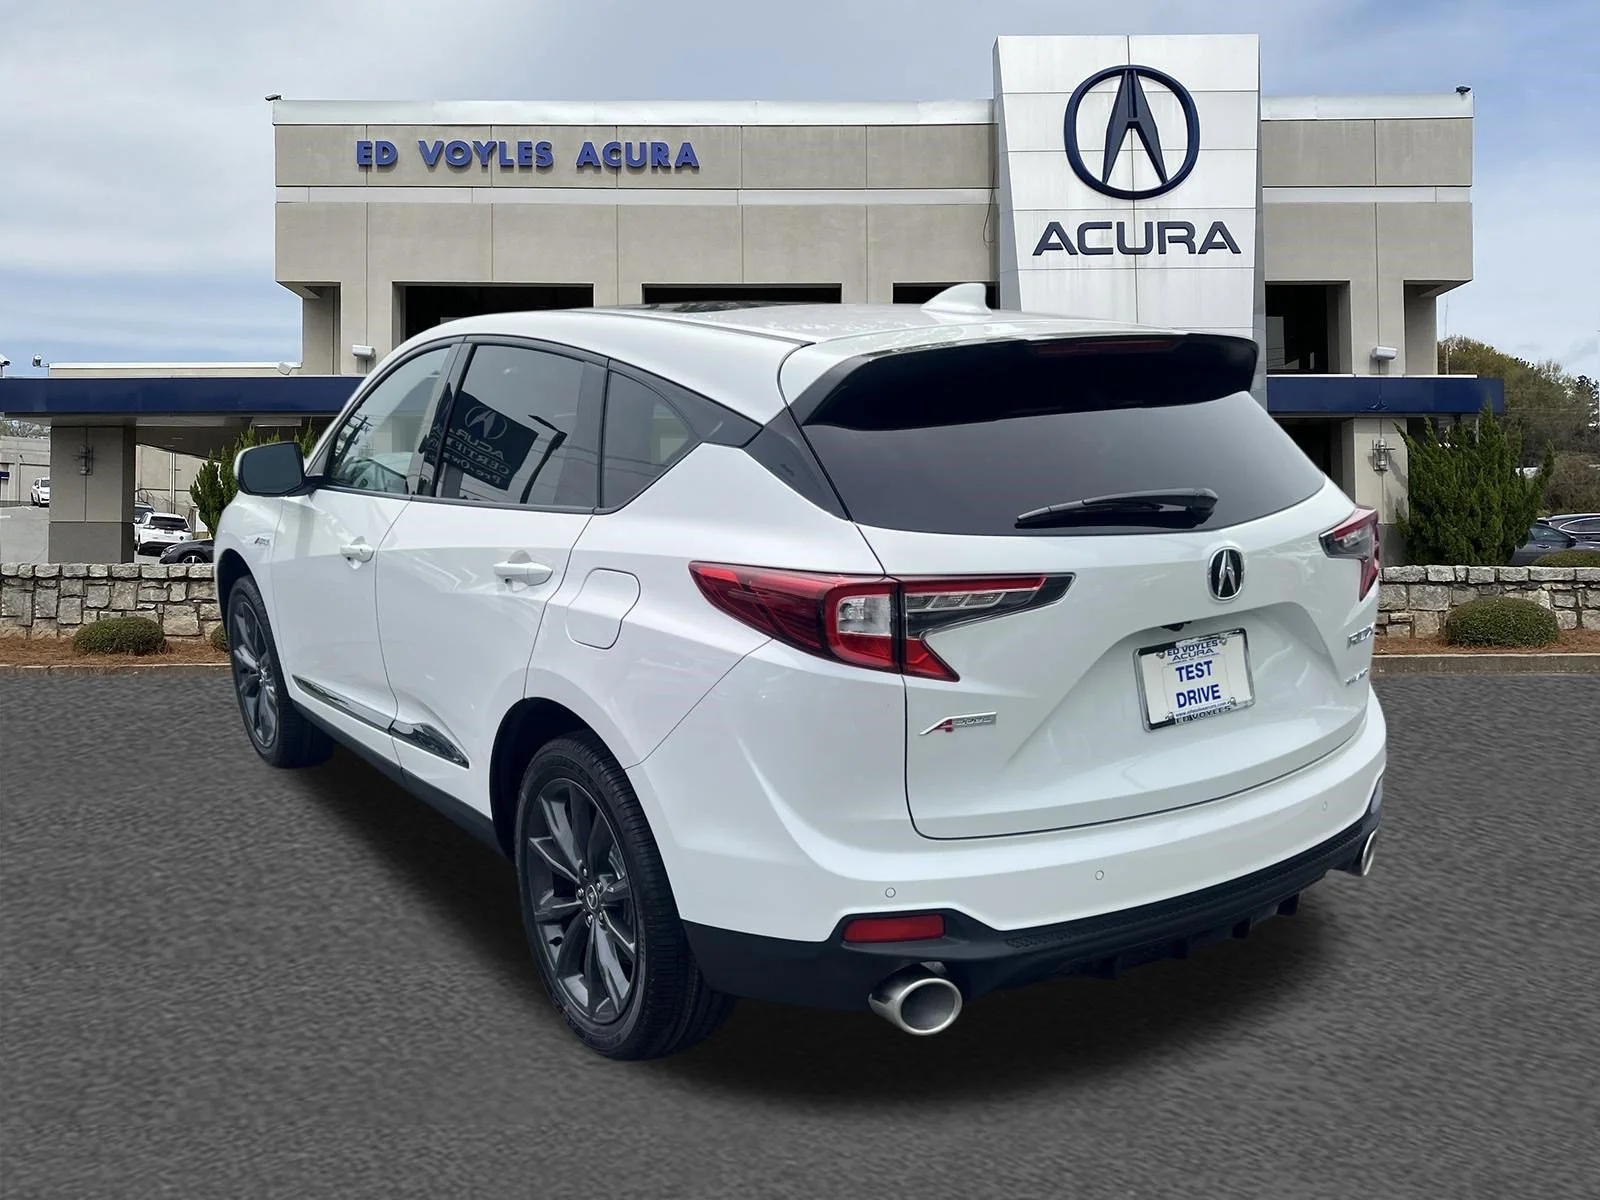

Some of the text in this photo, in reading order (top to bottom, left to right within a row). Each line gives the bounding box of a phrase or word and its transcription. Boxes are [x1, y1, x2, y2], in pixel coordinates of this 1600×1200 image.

[357, 140, 700, 168] ED VOYLES ACURA
[1032, 220, 1242, 256] ACURA
[1167, 639, 1218, 657] ED VOYLES
[1172, 648, 1215, 661] ACURA
[1175, 660, 1213, 682] TEST
[1176, 684, 1221, 708] DRIVE
